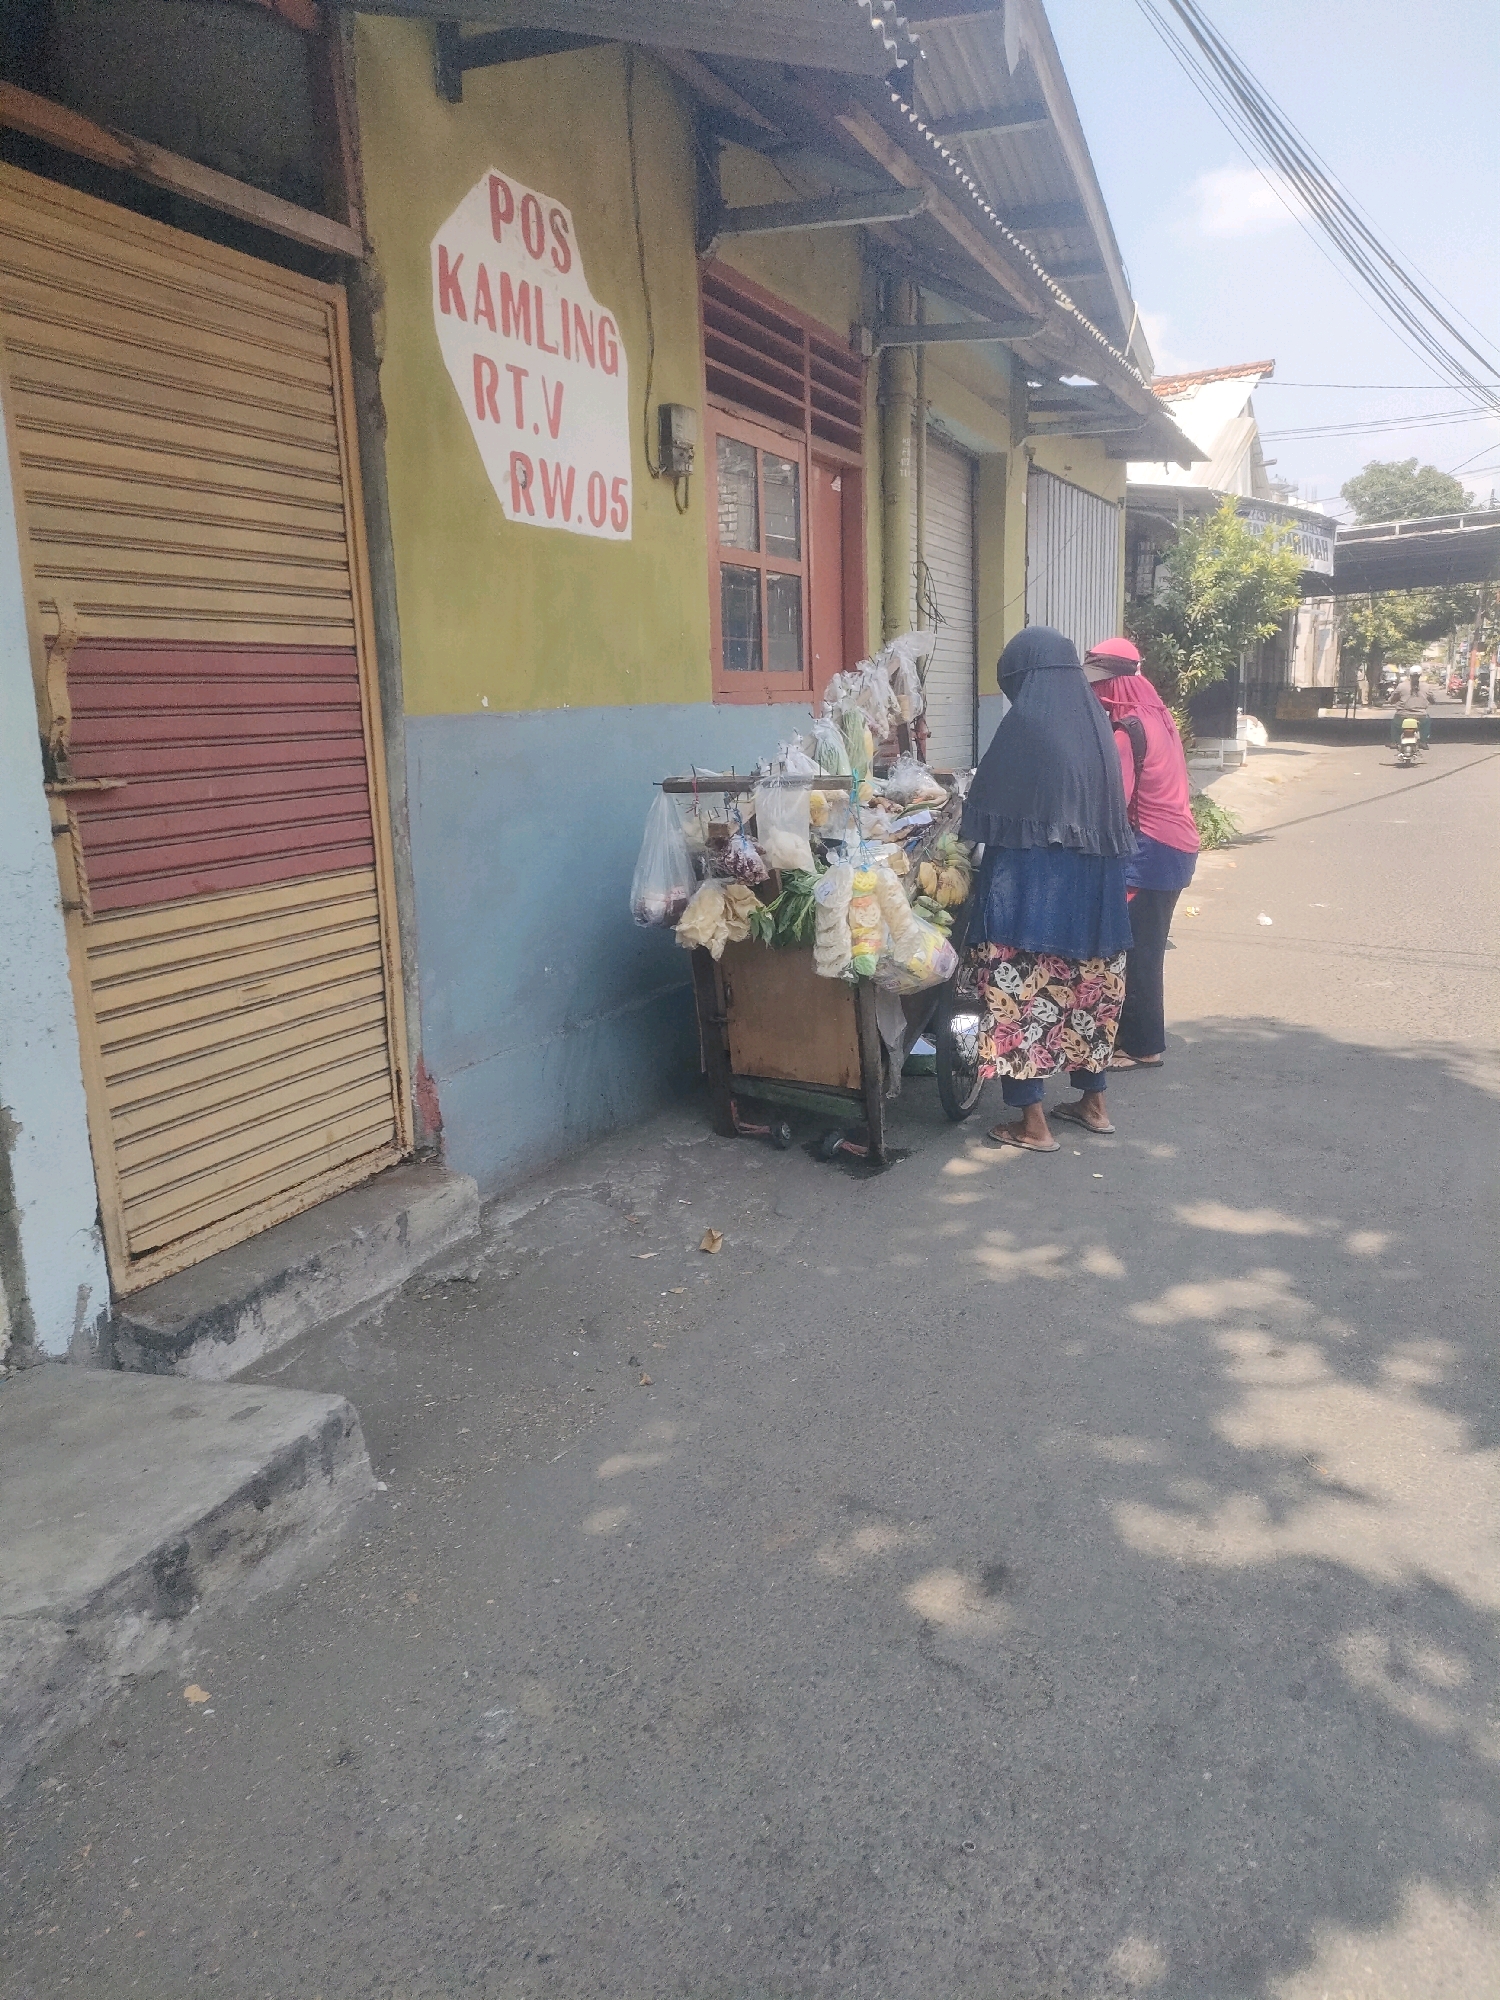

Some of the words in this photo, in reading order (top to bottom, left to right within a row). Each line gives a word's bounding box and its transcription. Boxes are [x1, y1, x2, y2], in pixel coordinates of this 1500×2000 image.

[488, 174, 571, 274] POS
[438, 244, 618, 376] KAMLING
[473, 353, 564, 440] RT.V
[510, 450, 628, 532] RW.05
